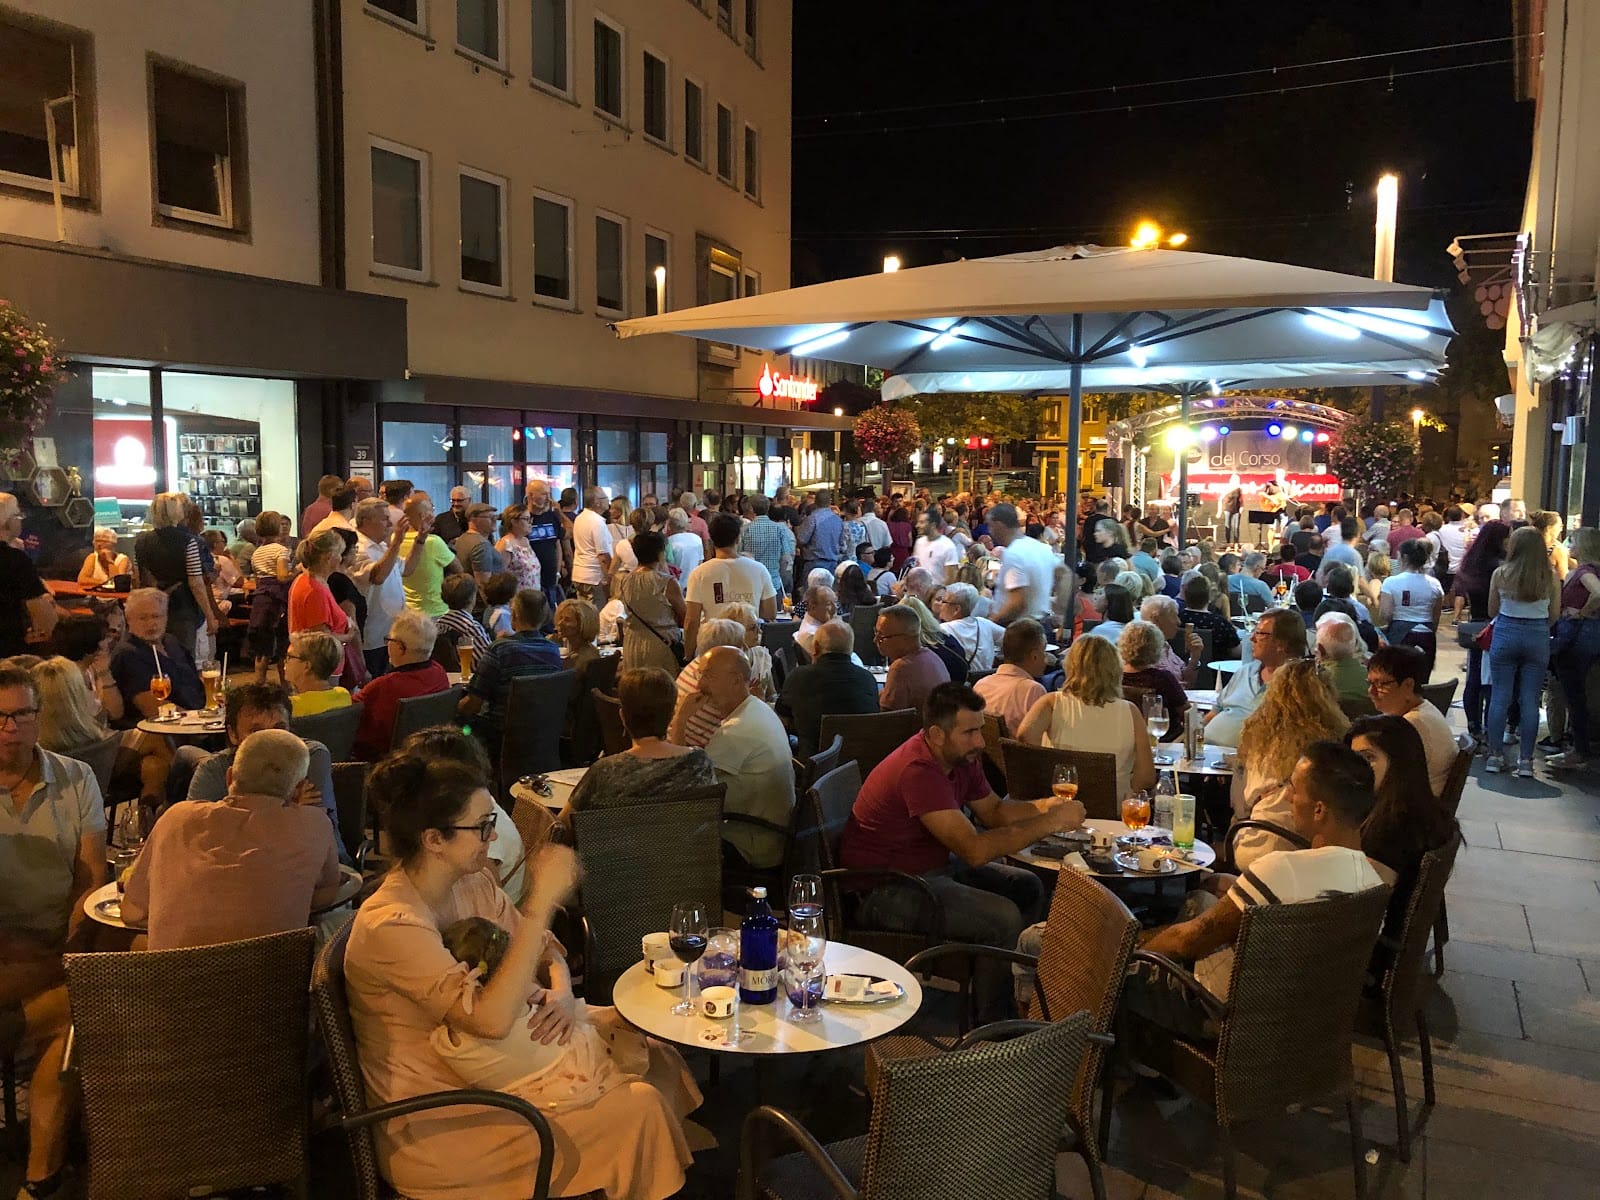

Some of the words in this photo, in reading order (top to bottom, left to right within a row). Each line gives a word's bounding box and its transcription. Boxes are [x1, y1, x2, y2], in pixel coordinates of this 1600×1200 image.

[356, 450, 367, 460] 39
[1210, 440, 1236, 467] del
[1240, 450, 1281, 466] Corso
